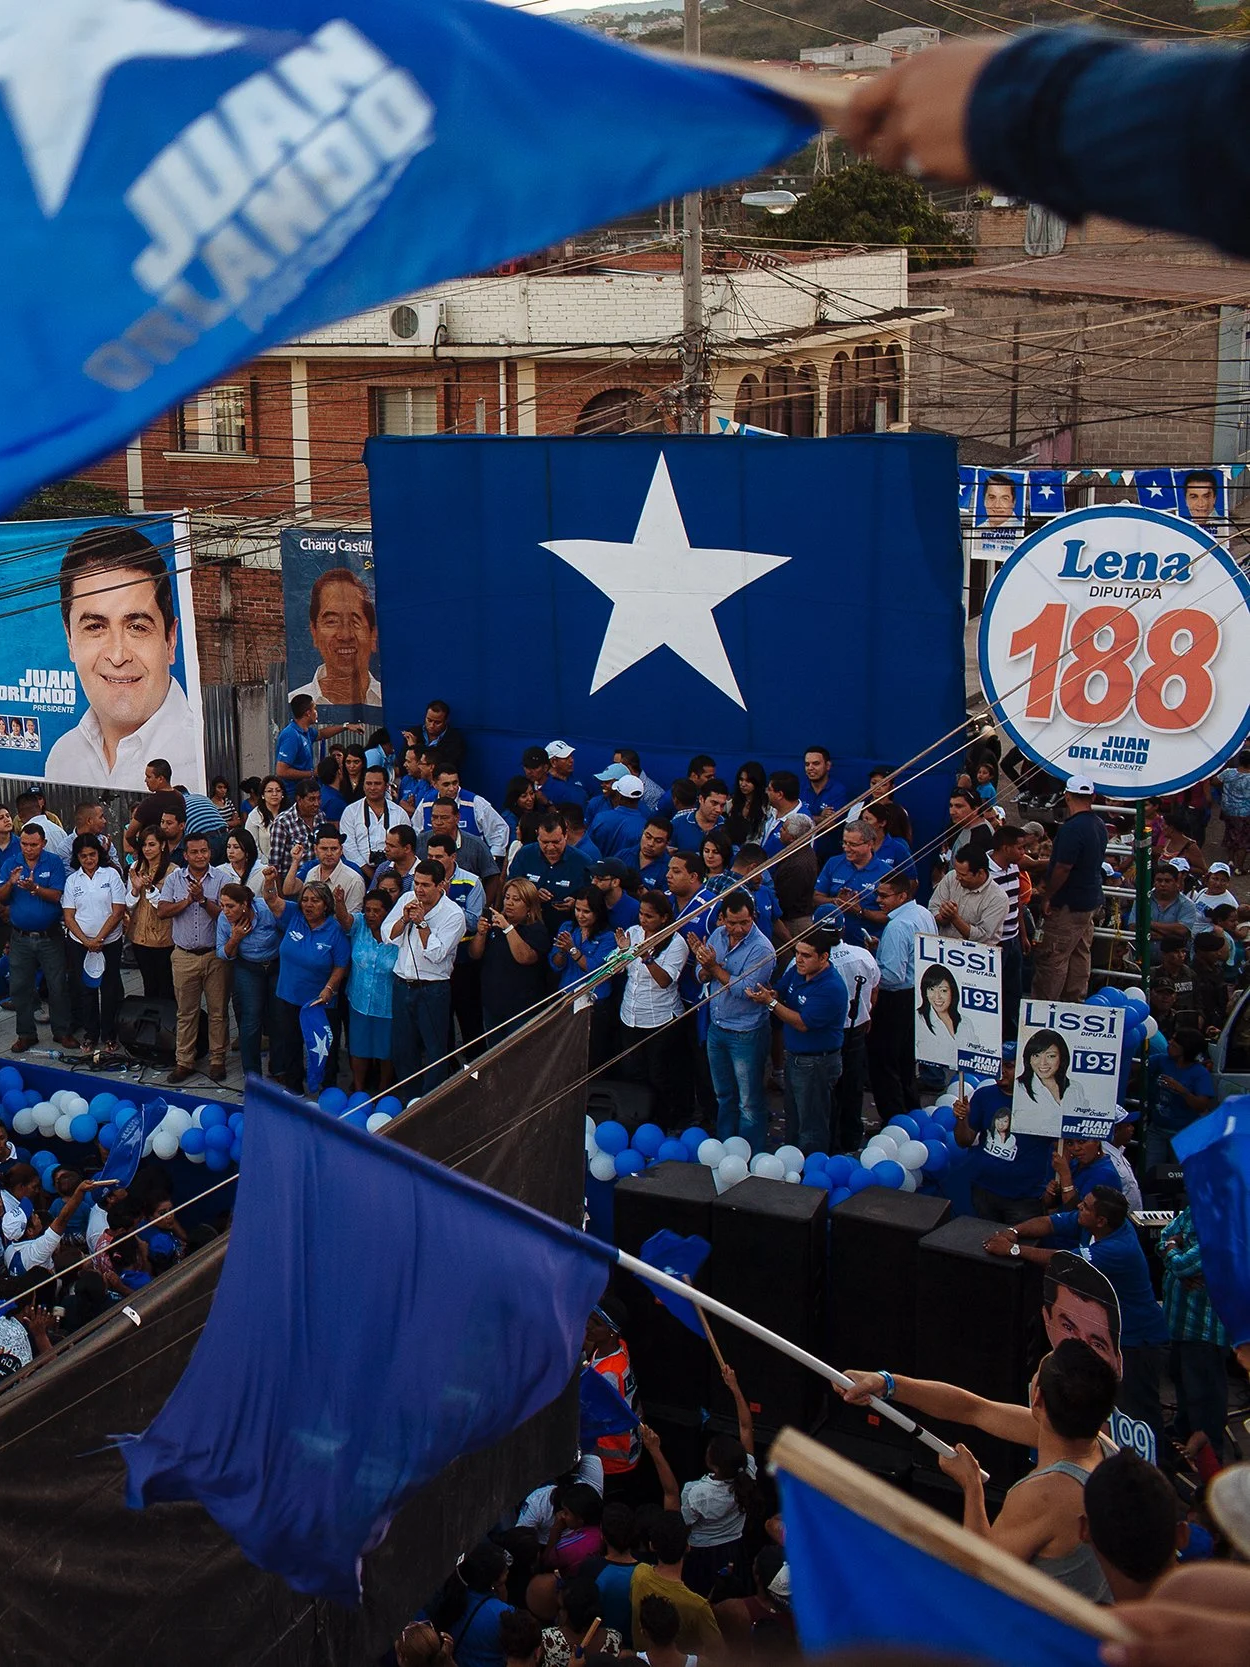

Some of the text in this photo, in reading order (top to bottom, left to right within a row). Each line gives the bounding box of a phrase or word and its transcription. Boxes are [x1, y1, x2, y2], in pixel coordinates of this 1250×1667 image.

[125, 18, 390, 293] JUAN
[299, 538, 373, 554] Chang Castill
[1057, 539, 1193, 583] Lena
[1089, 586, 1162, 600] DIPUTADA
[1008, 603, 1220, 730] 188
[19, 669, 76, 689] JUAN
[32, 704, 75, 714] PRESIDENTE
[1102, 736, 1150, 751] JUAN
[1068, 746, 1148, 764] ORLANDO
[1099, 762, 1143, 771] PRESIDENTE
[966, 968, 997, 978] DIPUTADA
[963, 989, 998, 1009] 193
[958, 1058, 999, 1073] ORLANDO
[971, 1055, 1000, 1067] JUAN
[1075, 1052, 1115, 1071] 193
[1062, 1124, 1111, 1136] ORLANDO
[1078, 1119, 1113, 1129] JUAN
[1107, 1410, 1152, 1462] 199
